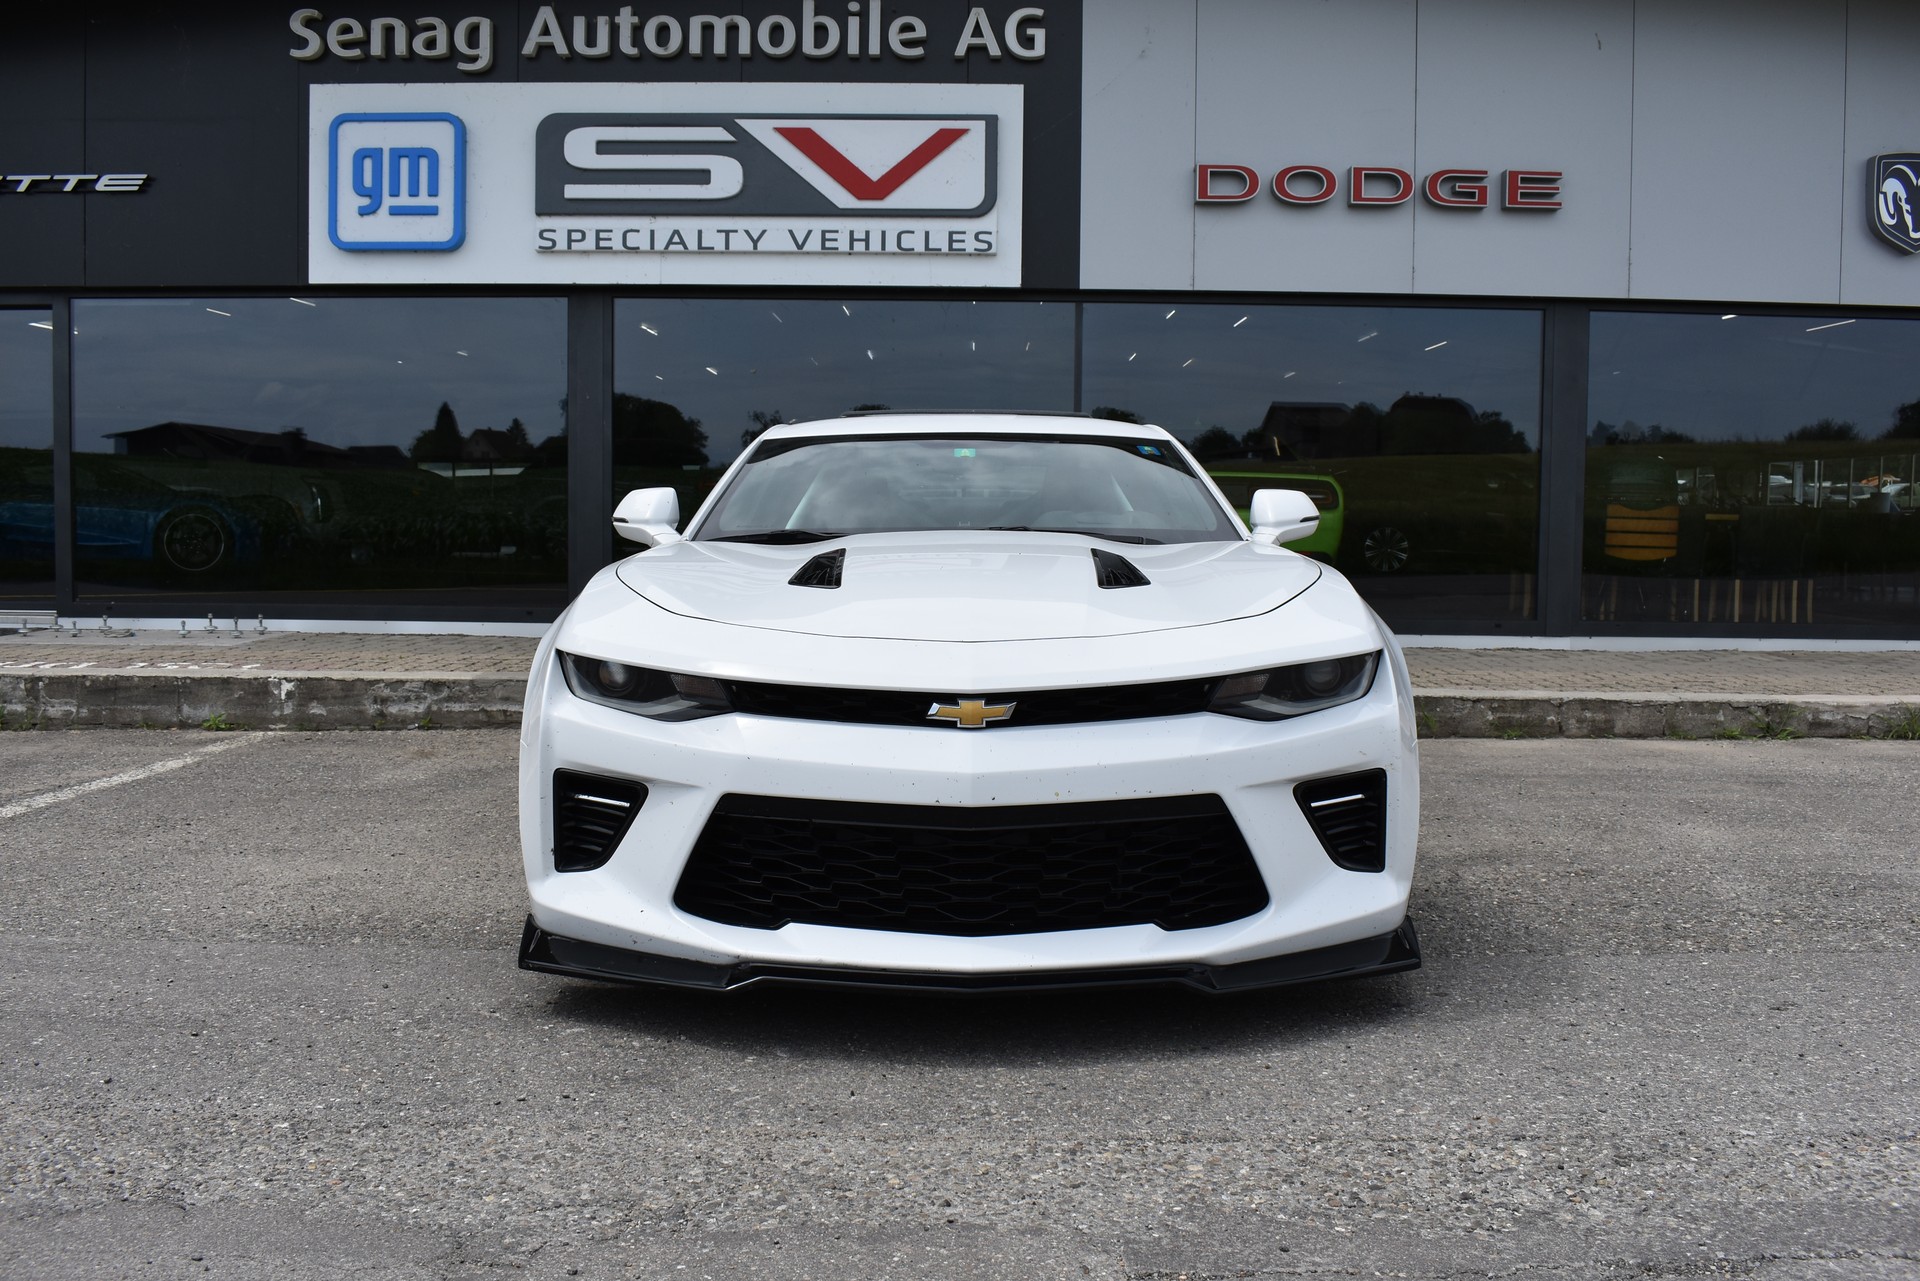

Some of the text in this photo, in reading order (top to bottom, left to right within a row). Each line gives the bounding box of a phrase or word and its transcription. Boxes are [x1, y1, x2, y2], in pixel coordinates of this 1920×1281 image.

[289, 1, 1047, 73] Senag Automobile AG
[0, 173, 149, 192] TTE
[352, 147, 440, 216] gm
[1195, 164, 1563, 211] DODGE
[537, 228, 994, 253] SPECIALTY VEHICLES
